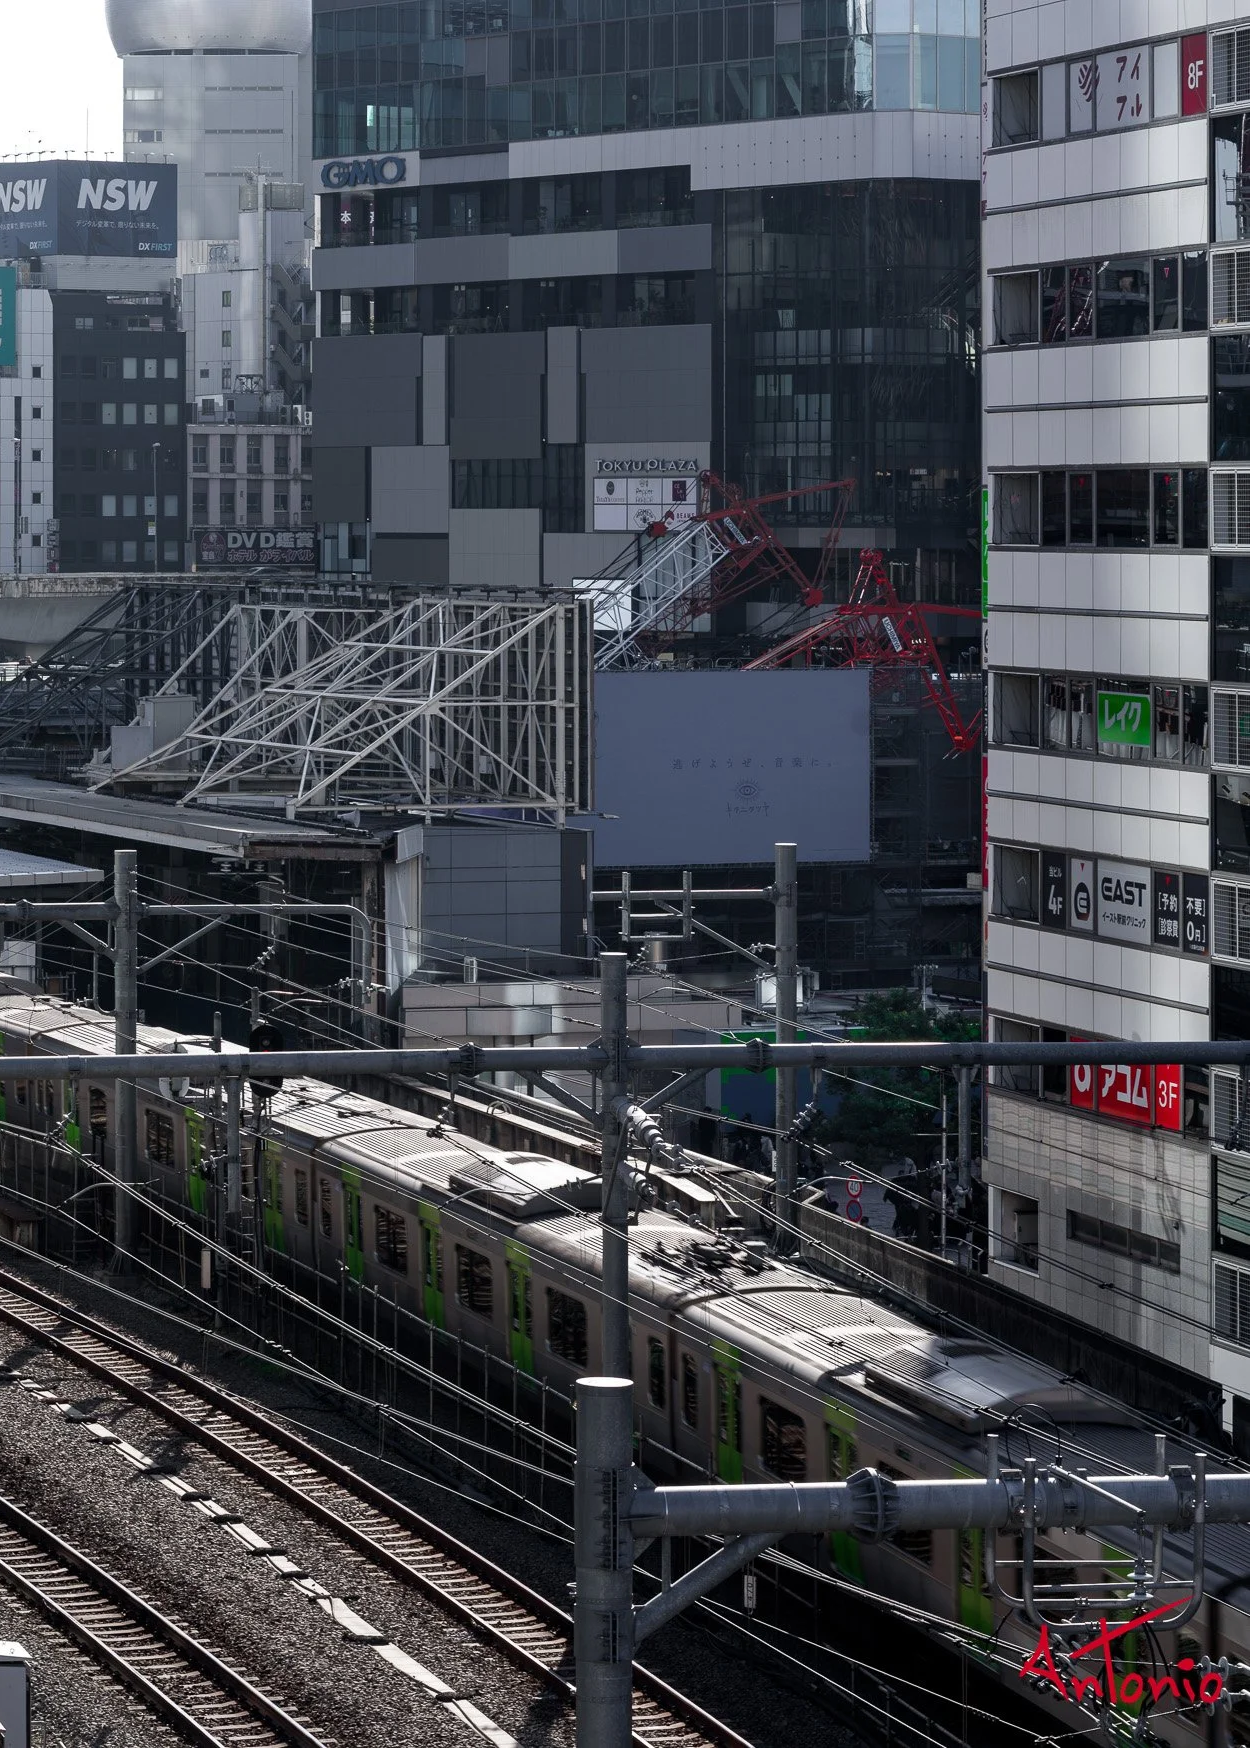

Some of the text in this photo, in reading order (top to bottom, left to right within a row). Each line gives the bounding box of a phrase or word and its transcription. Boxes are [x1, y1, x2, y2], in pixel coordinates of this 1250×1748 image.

[1116, 53, 1141, 82] アイ
[1188, 60, 1203, 90] 8F
[1117, 93, 1142, 121] フル
[321, 156, 406, 189] GMO
[77, 178, 158, 211] NSW
[138, 243, 172, 251] DX FIRST
[595, 460, 697, 471] TOKYU PLAZA
[228, 532, 314, 548] DVD鑑賞
[1105, 700, 1141, 732] レイク
[1049, 885, 1063, 915] 4F
[1101, 877, 1146, 907] EAST
[1102, 912, 1146, 929] イースト駅前クリニック
[1158, 1080, 1178, 1108] 3F
[850, 1181, 859, 1193] 40
